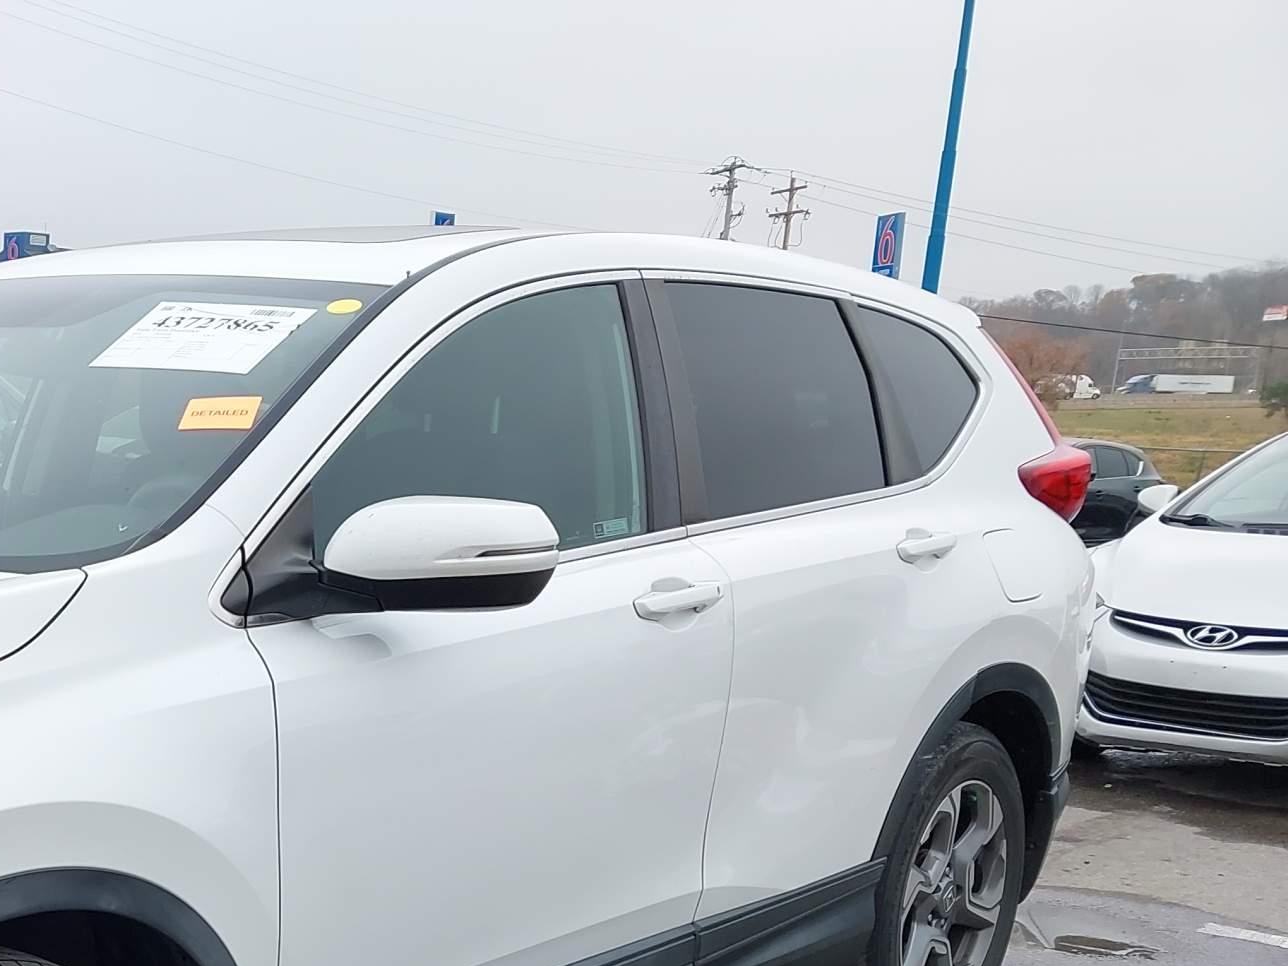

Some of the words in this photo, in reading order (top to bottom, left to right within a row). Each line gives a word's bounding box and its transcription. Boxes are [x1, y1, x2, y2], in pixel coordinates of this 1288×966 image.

[877, 215, 896, 265] 6
[152, 315, 281, 333] 43727865
[190, 408, 250, 417] DETAILED
